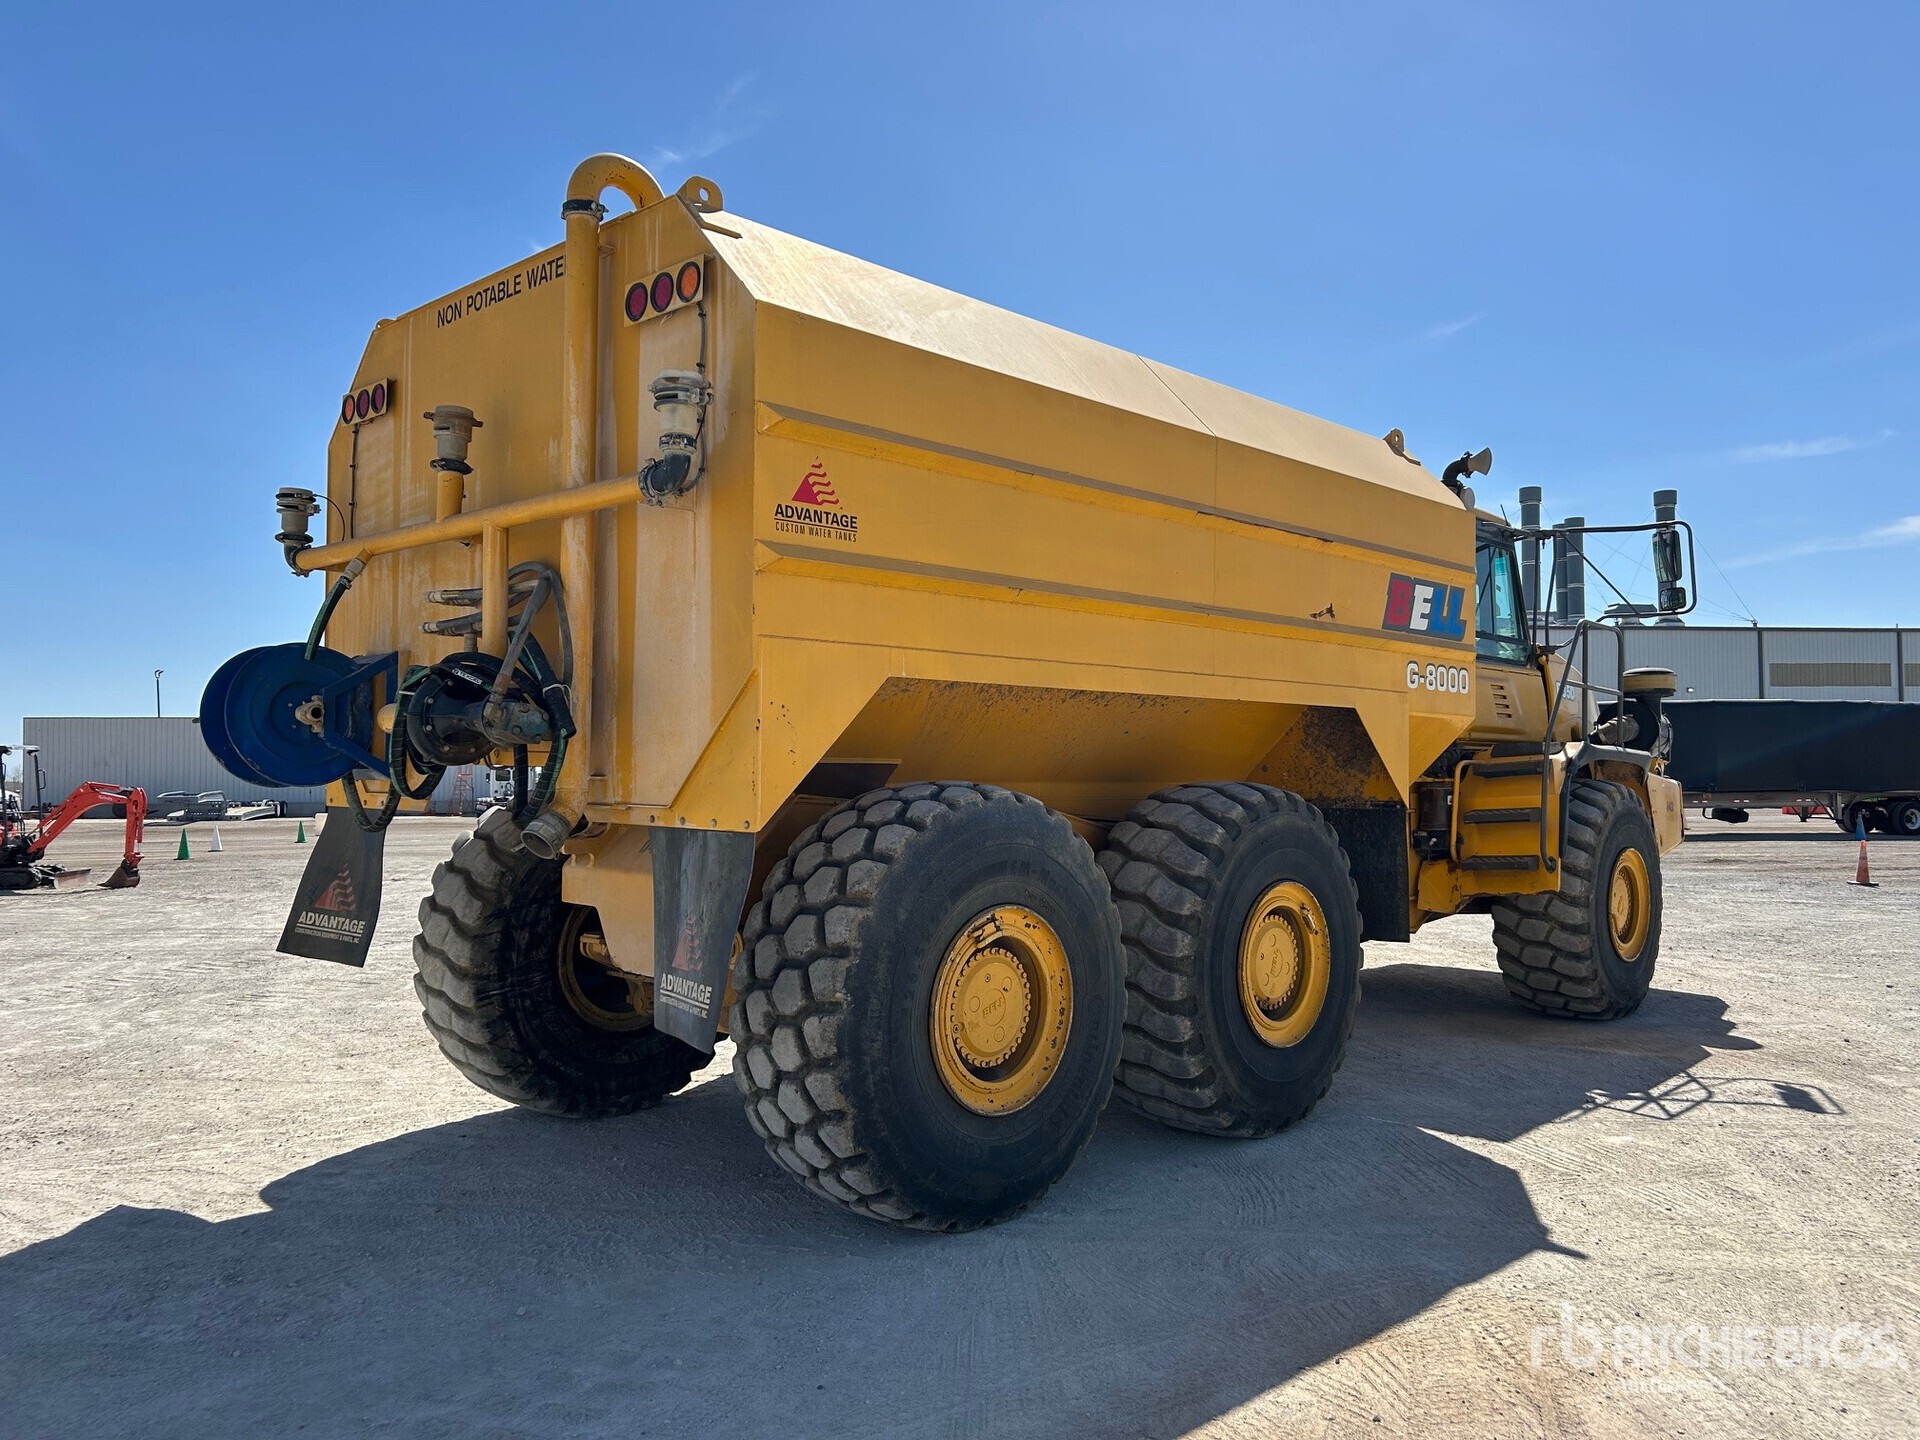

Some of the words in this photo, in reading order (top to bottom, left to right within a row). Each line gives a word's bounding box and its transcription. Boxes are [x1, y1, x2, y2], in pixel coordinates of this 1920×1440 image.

[437, 300, 462, 328] NON
[466, 273, 522, 316] POTABLE
[527, 254, 566, 289] WATE
[774, 503, 858, 529] ADVANTAGE
[775, 521, 806, 535] CUSTOM
[808, 526, 832, 539] WATER
[835, 530, 857, 543] TANKS
[1384, 575, 1467, 640] BELL
[1406, 660, 1469, 694] G-8000
[298, 911, 366, 933] ADVANTAGE
[661, 972, 712, 1004] ADVANTAGE
